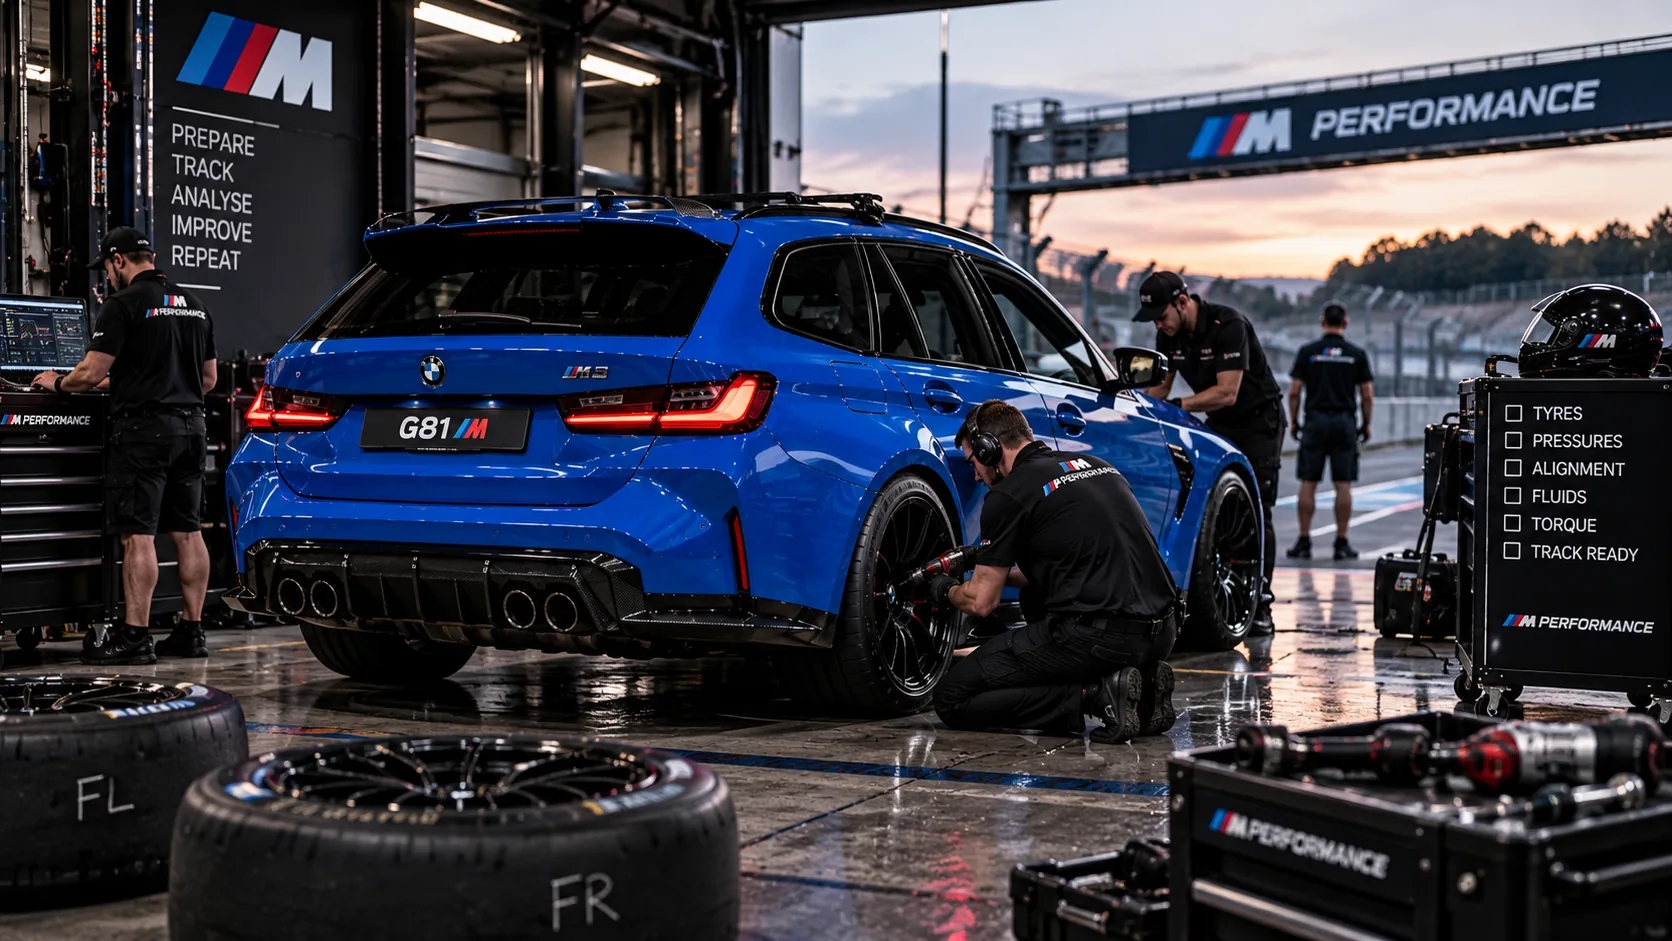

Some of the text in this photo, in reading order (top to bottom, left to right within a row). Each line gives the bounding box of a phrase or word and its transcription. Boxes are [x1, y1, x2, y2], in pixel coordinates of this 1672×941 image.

[1311, 78, 1600, 140] PERFORMANCE
[172, 123, 255, 156] PREPARE
[171, 153, 235, 183] TRACK
[171, 184, 253, 215] ANALYSE
[172, 214, 253, 244] IMPROVE
[172, 244, 242, 271] REPEAT
[22, 415, 91, 426] PERFORMANCE
[1533, 406, 1583, 421] TYRES
[399, 416, 450, 439] G81
[1533, 433, 1623, 449] PRESSURES
[1532, 461, 1625, 477] ALIGNMENT
[1532, 489, 1587, 504] FLUIDS
[1531, 516, 1597, 533] TORQUE
[1531, 544, 1639, 562] TRACK READY
[1538, 616, 1655, 634] PERFORMANCE
[77, 774, 135, 822] FL
[1249, 818, 1390, 880] PERFORMANCE
[551, 872, 620, 932] FR
